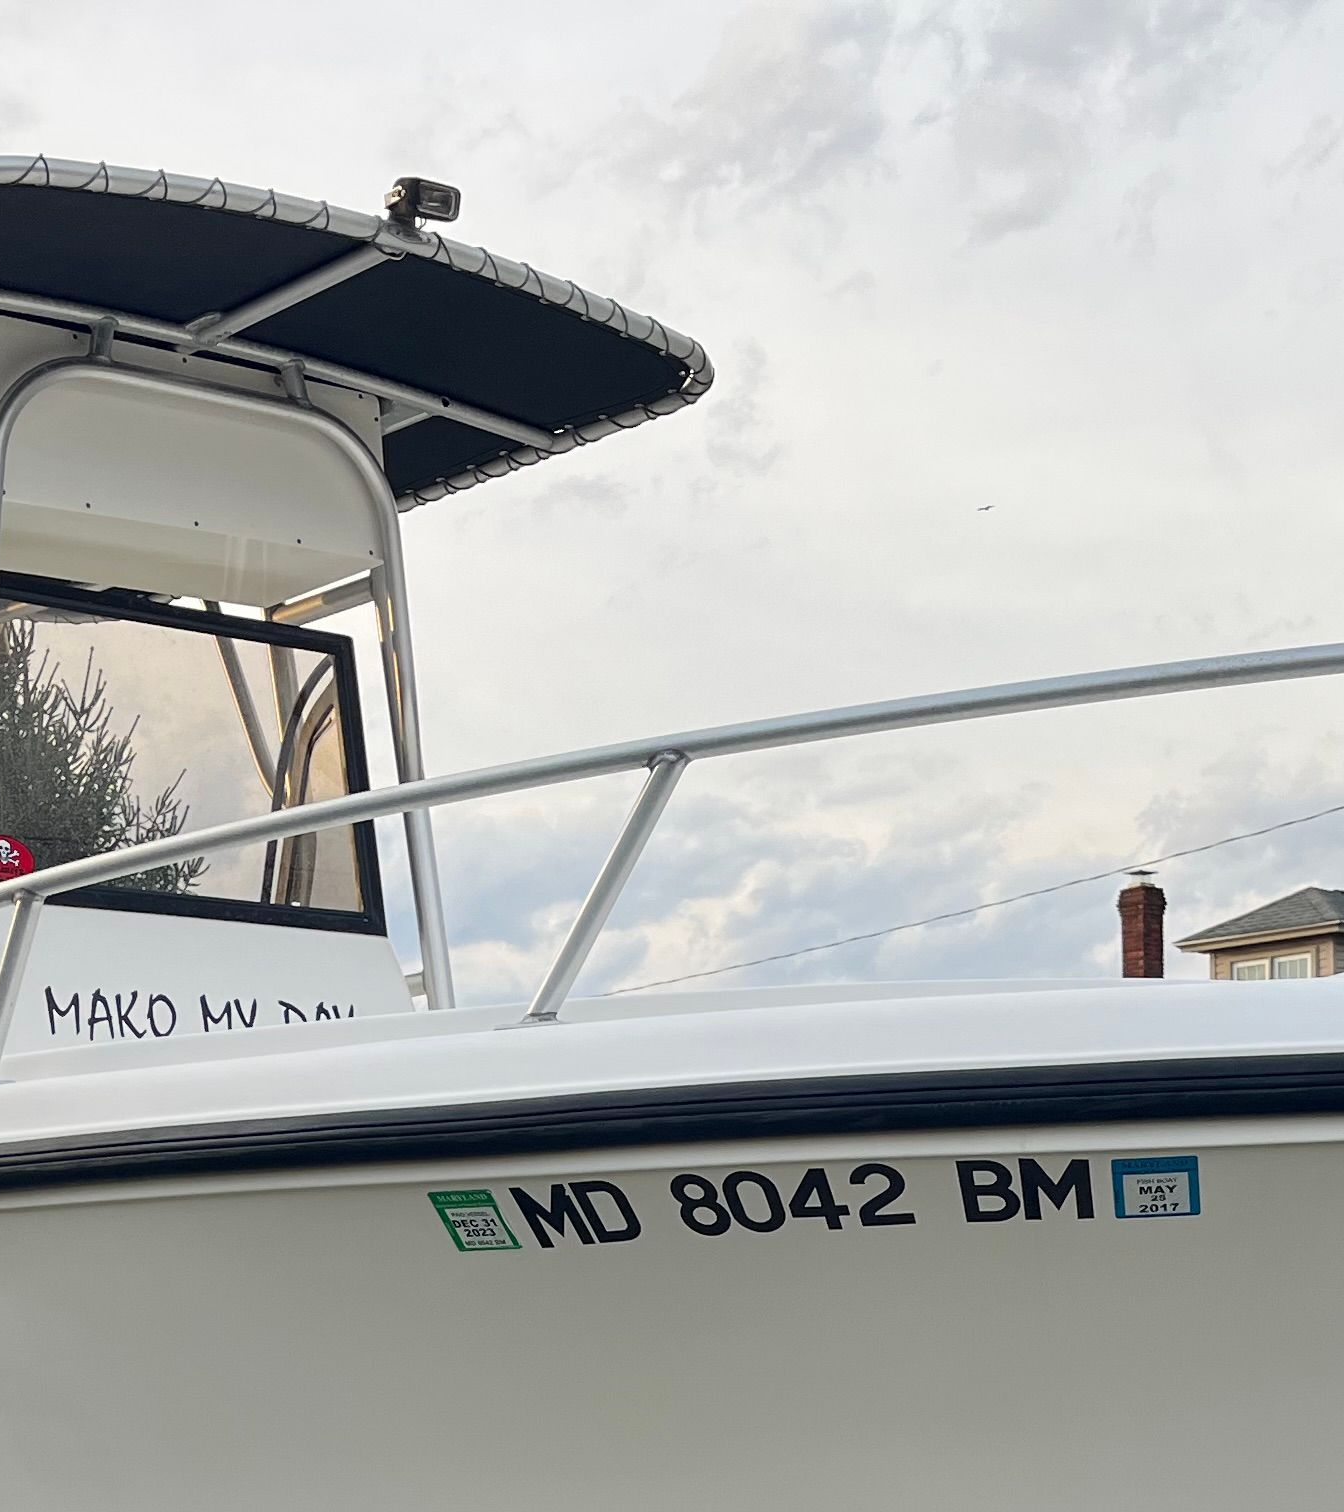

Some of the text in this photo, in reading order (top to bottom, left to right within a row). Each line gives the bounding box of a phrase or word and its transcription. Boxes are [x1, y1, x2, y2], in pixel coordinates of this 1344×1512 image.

[44, 986, 177, 1041] MAKO
[1139, 1184, 1178, 1195] MAY
[437, 1194, 487, 1202] MARYLAND
[510, 1158, 1095, 1249] MD 8042 BM
[1139, 1202, 1180, 1213] 2017
[452, 1218, 498, 1228] DEC 31
[464, 1228, 497, 1238] 2023
